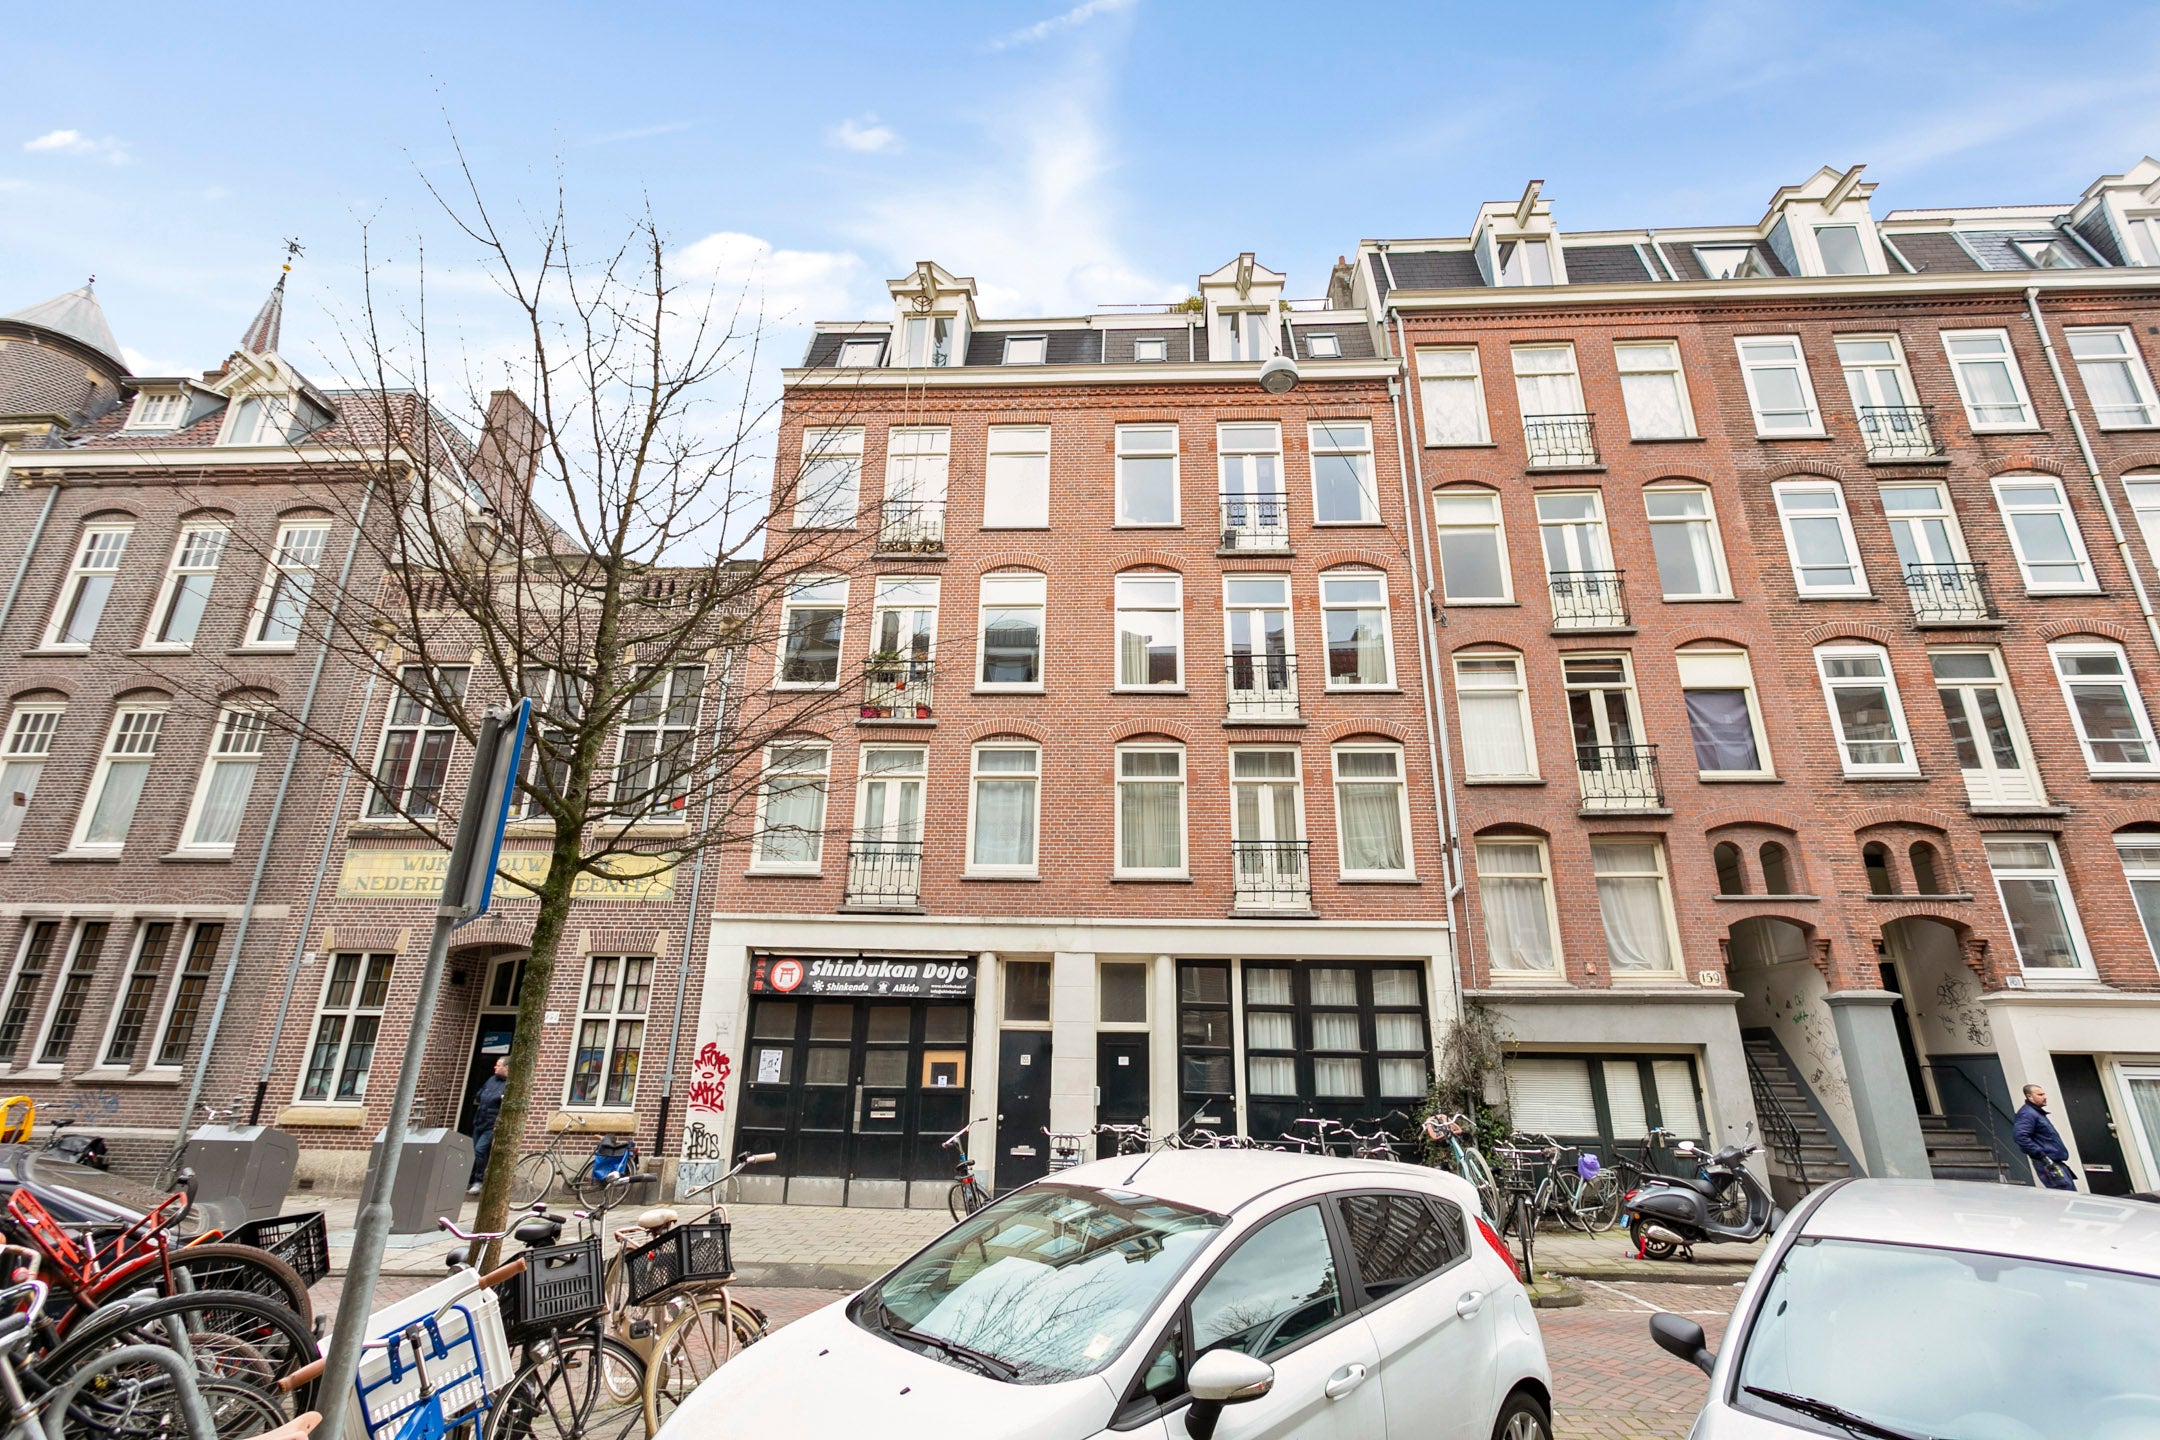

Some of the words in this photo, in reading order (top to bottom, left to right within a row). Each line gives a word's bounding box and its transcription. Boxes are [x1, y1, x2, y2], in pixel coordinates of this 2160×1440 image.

[403, 856, 546, 872] WIJKOUW
[809, 959, 918, 979] Shinbukan
[922, 961, 969, 983] Dojo
[1702, 972, 1720, 984] 159
[826, 983, 869, 992] Shinkendo
[892, 983, 920, 993] Aikido
